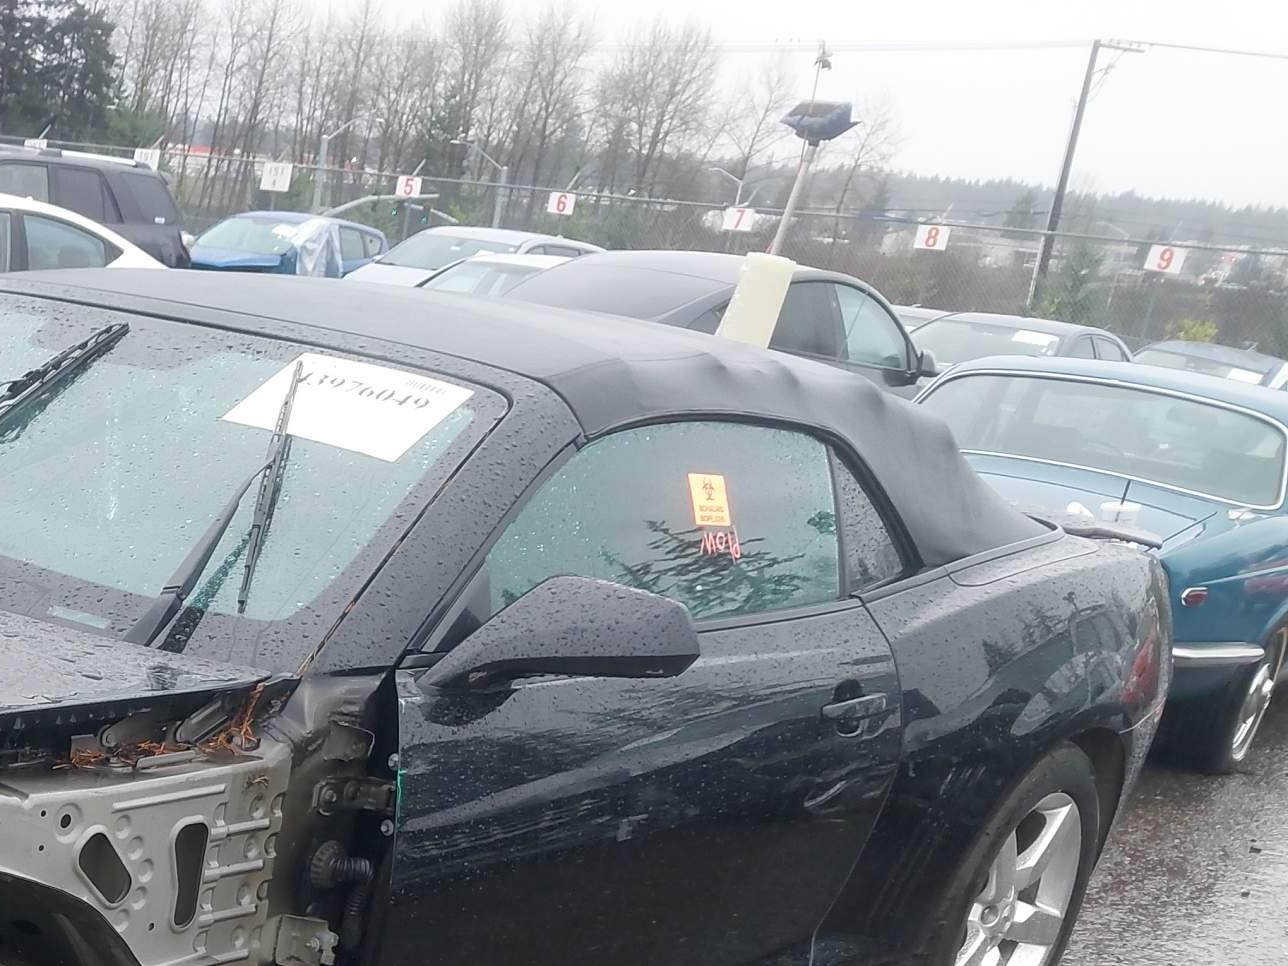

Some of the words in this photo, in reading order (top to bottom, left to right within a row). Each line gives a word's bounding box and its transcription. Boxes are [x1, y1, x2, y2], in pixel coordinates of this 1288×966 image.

[403, 176, 414, 196] 5
[556, 194, 568, 213] 6
[734, 207, 746, 229] 7
[924, 226, 940, 248] 8
[1157, 247, 1174, 271] 9
